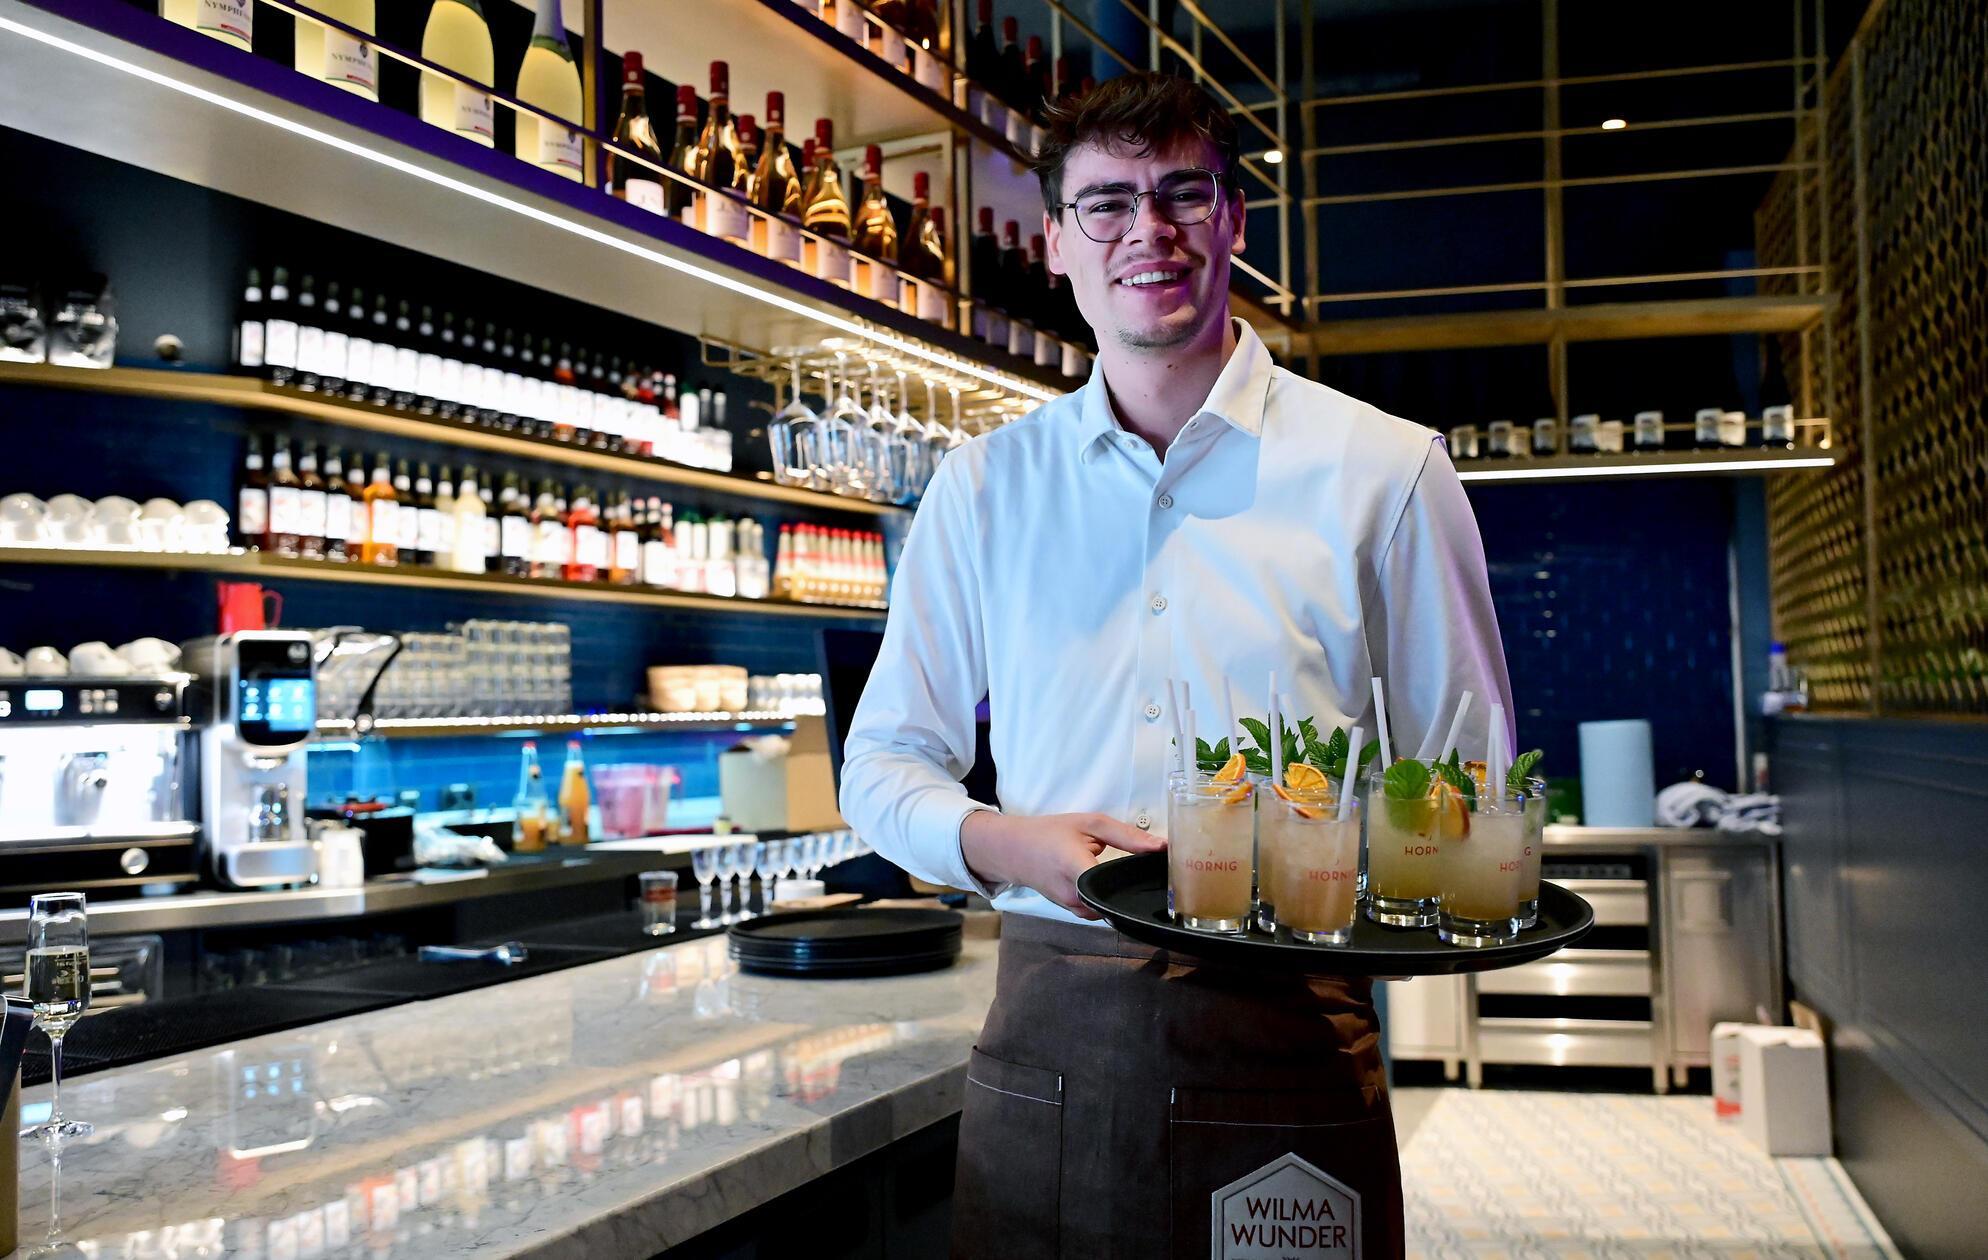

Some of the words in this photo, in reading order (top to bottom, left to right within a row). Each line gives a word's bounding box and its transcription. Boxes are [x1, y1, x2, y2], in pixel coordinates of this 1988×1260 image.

[1185, 859, 1238, 872] HORNIG
[1246, 1197, 1335, 1221] WILMA
[1231, 1223, 1347, 1248] WUNDER
